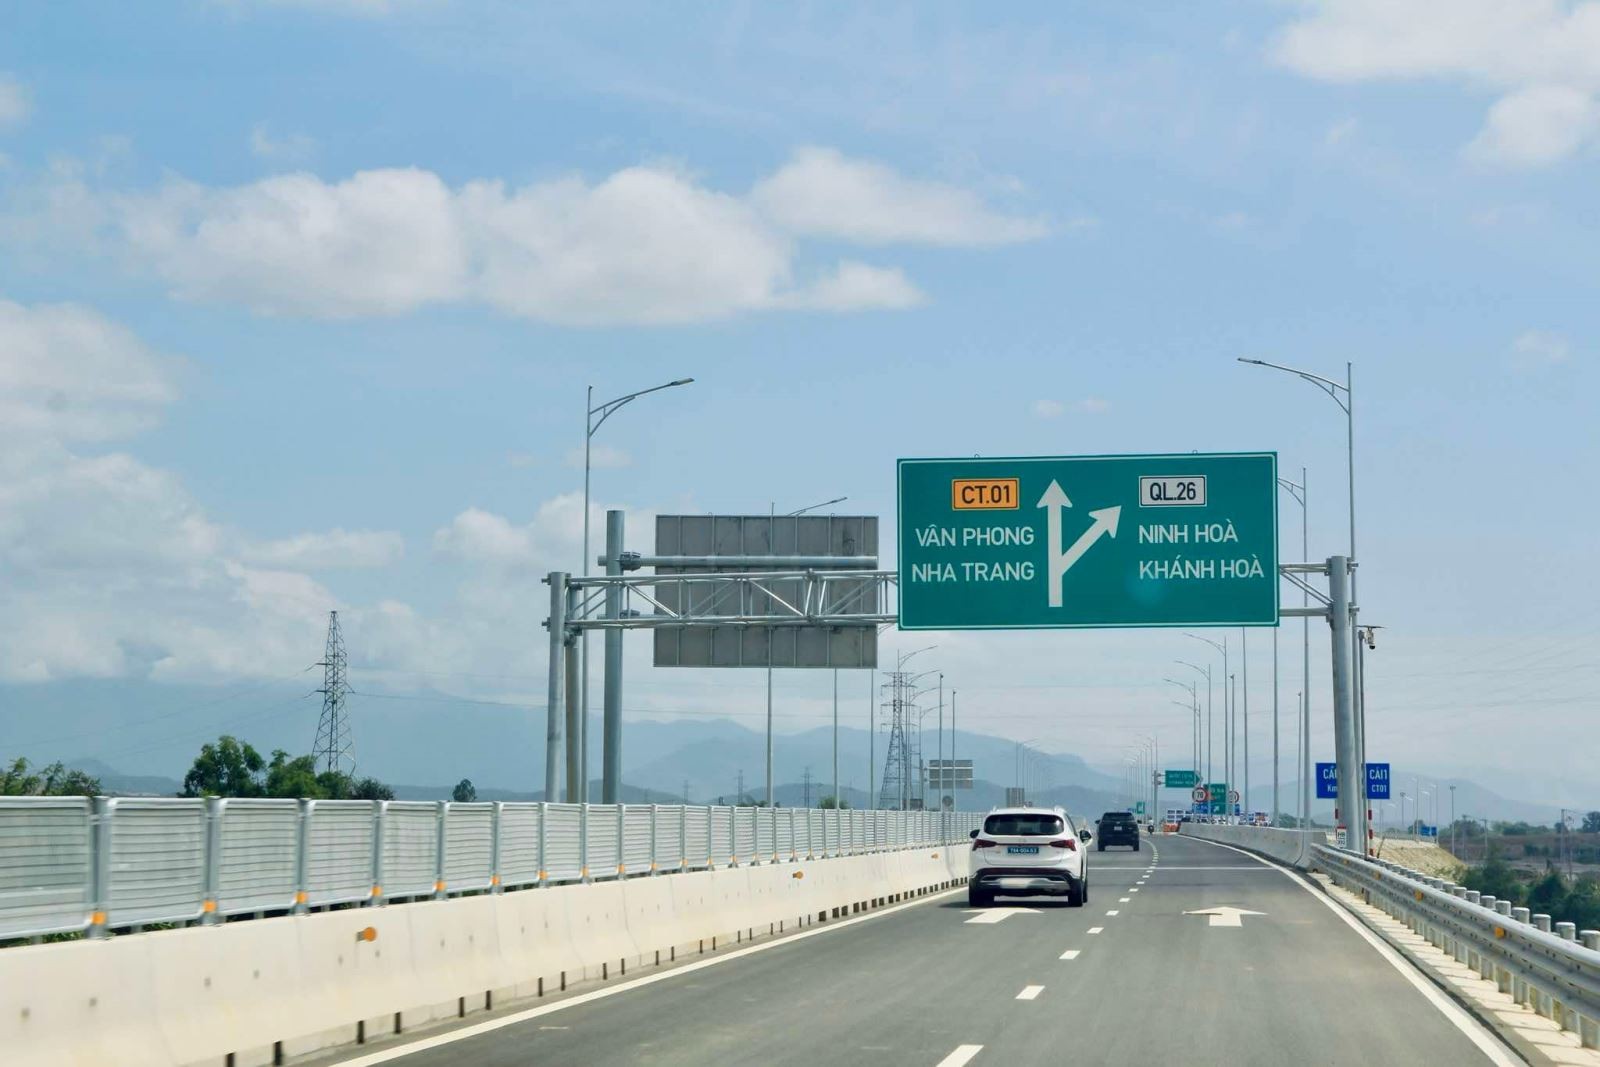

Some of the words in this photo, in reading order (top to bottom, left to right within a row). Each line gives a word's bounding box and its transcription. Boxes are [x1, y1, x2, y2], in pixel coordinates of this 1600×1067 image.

[961, 484, 1010, 504] CT.01
[1150, 481, 1196, 501] QL.26
[915, 525, 956, 547] VÂN
[962, 525, 1035, 547] PHONG
[1139, 524, 1189, 544] NINH
[1194, 518, 1239, 543] HOÀ
[911, 563, 957, 583] NHA
[961, 561, 1035, 582] TRANG
[1139, 554, 1215, 580] KHÁNH
[1220, 554, 1264, 578] HOÀ
[1196, 791, 1204, 799] 70
[1371, 784, 1387, 793] CT01
